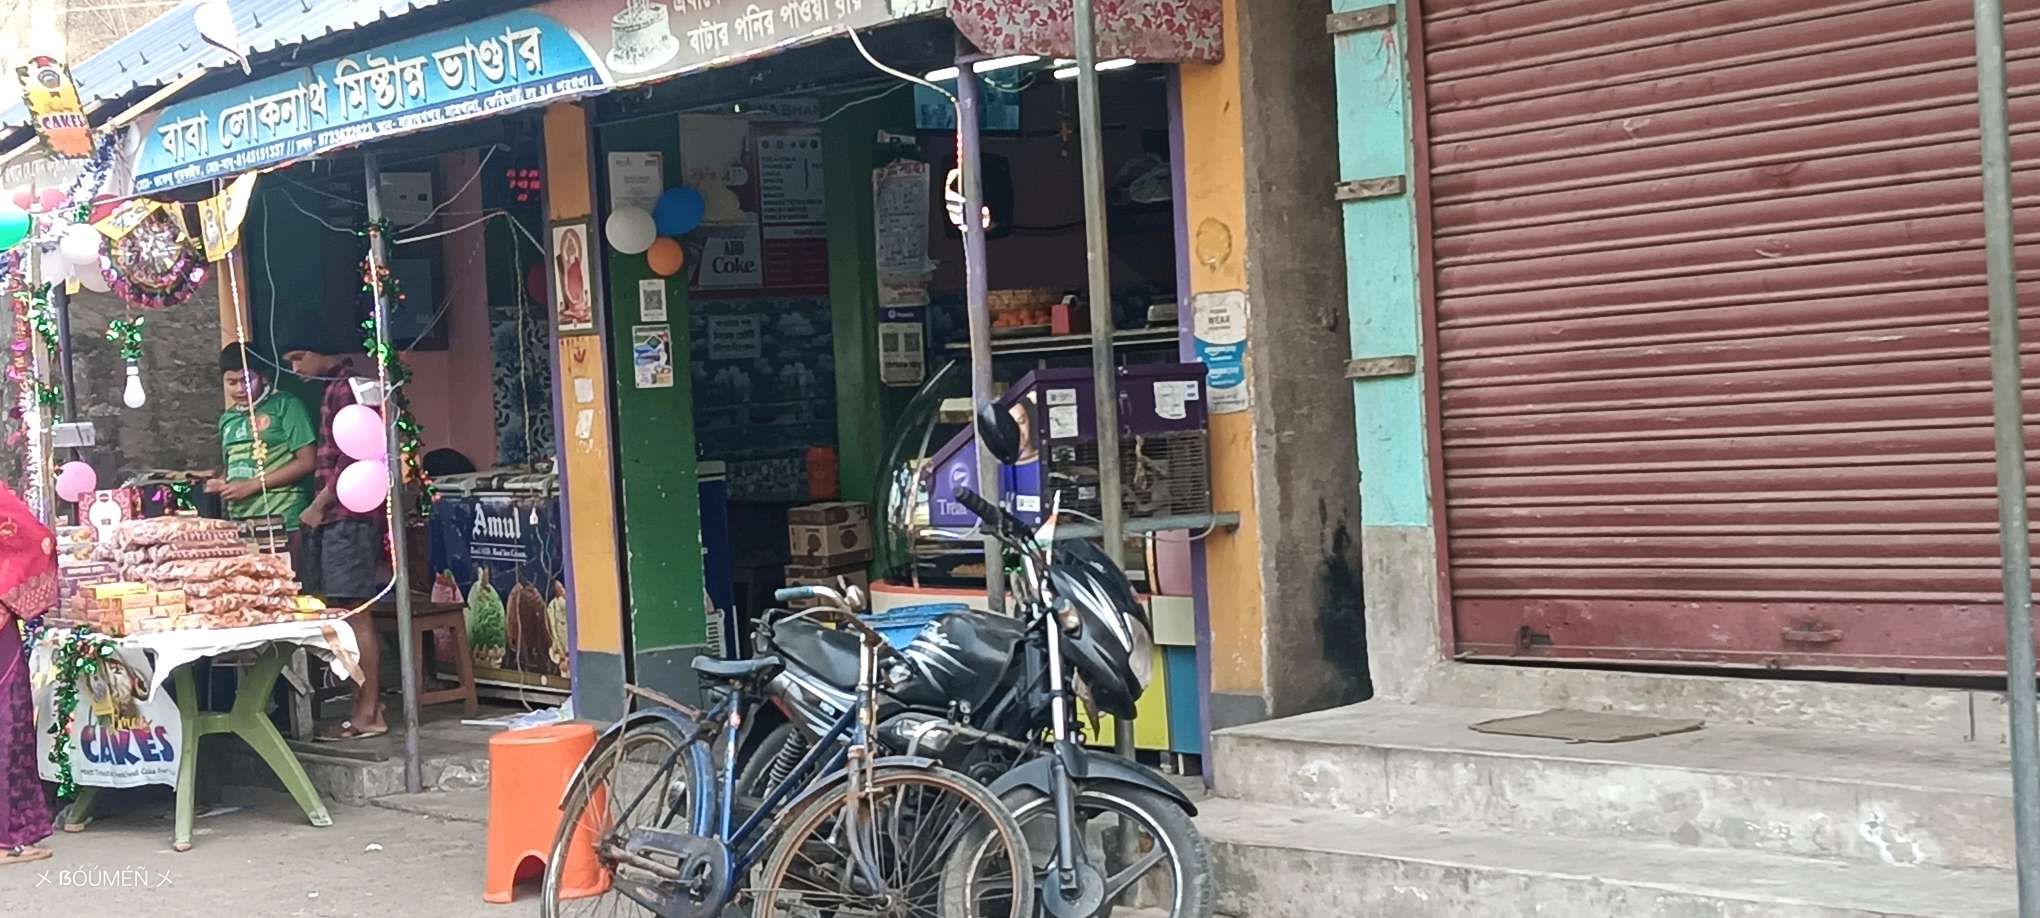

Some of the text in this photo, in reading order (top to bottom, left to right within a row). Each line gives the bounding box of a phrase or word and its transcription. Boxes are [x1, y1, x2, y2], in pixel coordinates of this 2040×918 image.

[687, 20, 729, 56] বাটার
[735, 4, 774, 42] পনির
[157, 109, 210, 162] বাবা
[218, 75, 328, 149] লোকনাথ
[333, 54, 428, 120] মিষ্টান্ন
[432, 25, 542, 91] ভাণ্ডার
[712, 256, 755, 274] Coke
[472, 502, 521, 540] Amul
[81, 726, 174, 765] CAKES
